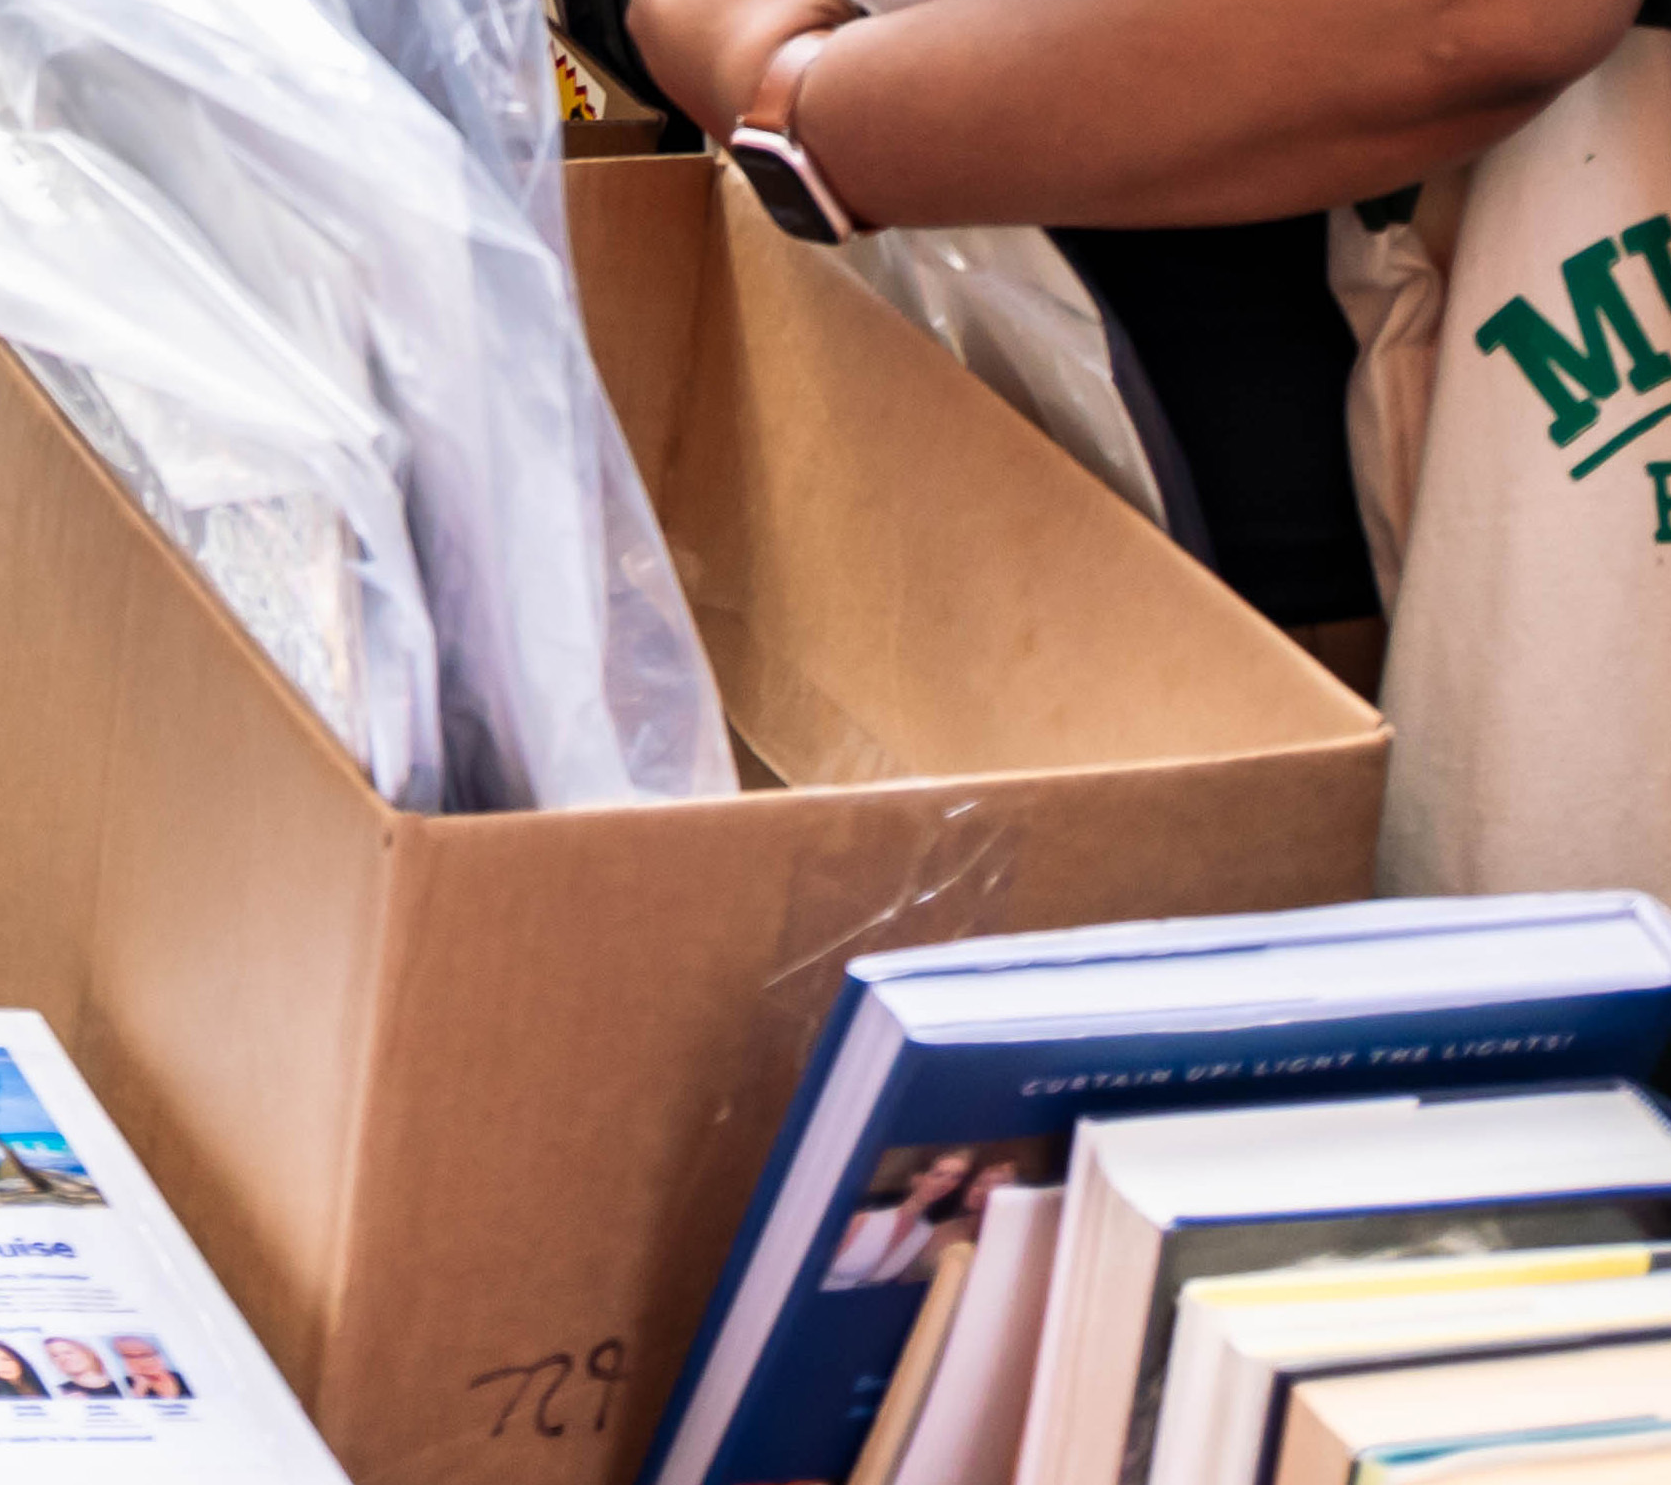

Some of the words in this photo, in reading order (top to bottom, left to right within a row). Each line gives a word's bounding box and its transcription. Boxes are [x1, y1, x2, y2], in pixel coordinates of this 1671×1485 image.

[1020, 1069, 1173, 1098] CURTAIN
[1184, 1061, 1244, 1083] UP!
[1252, 1051, 1359, 1078] LIGHT
[1369, 1045, 1433, 1067] THE
[1440, 1032, 1578, 1061] LIGHTS!
